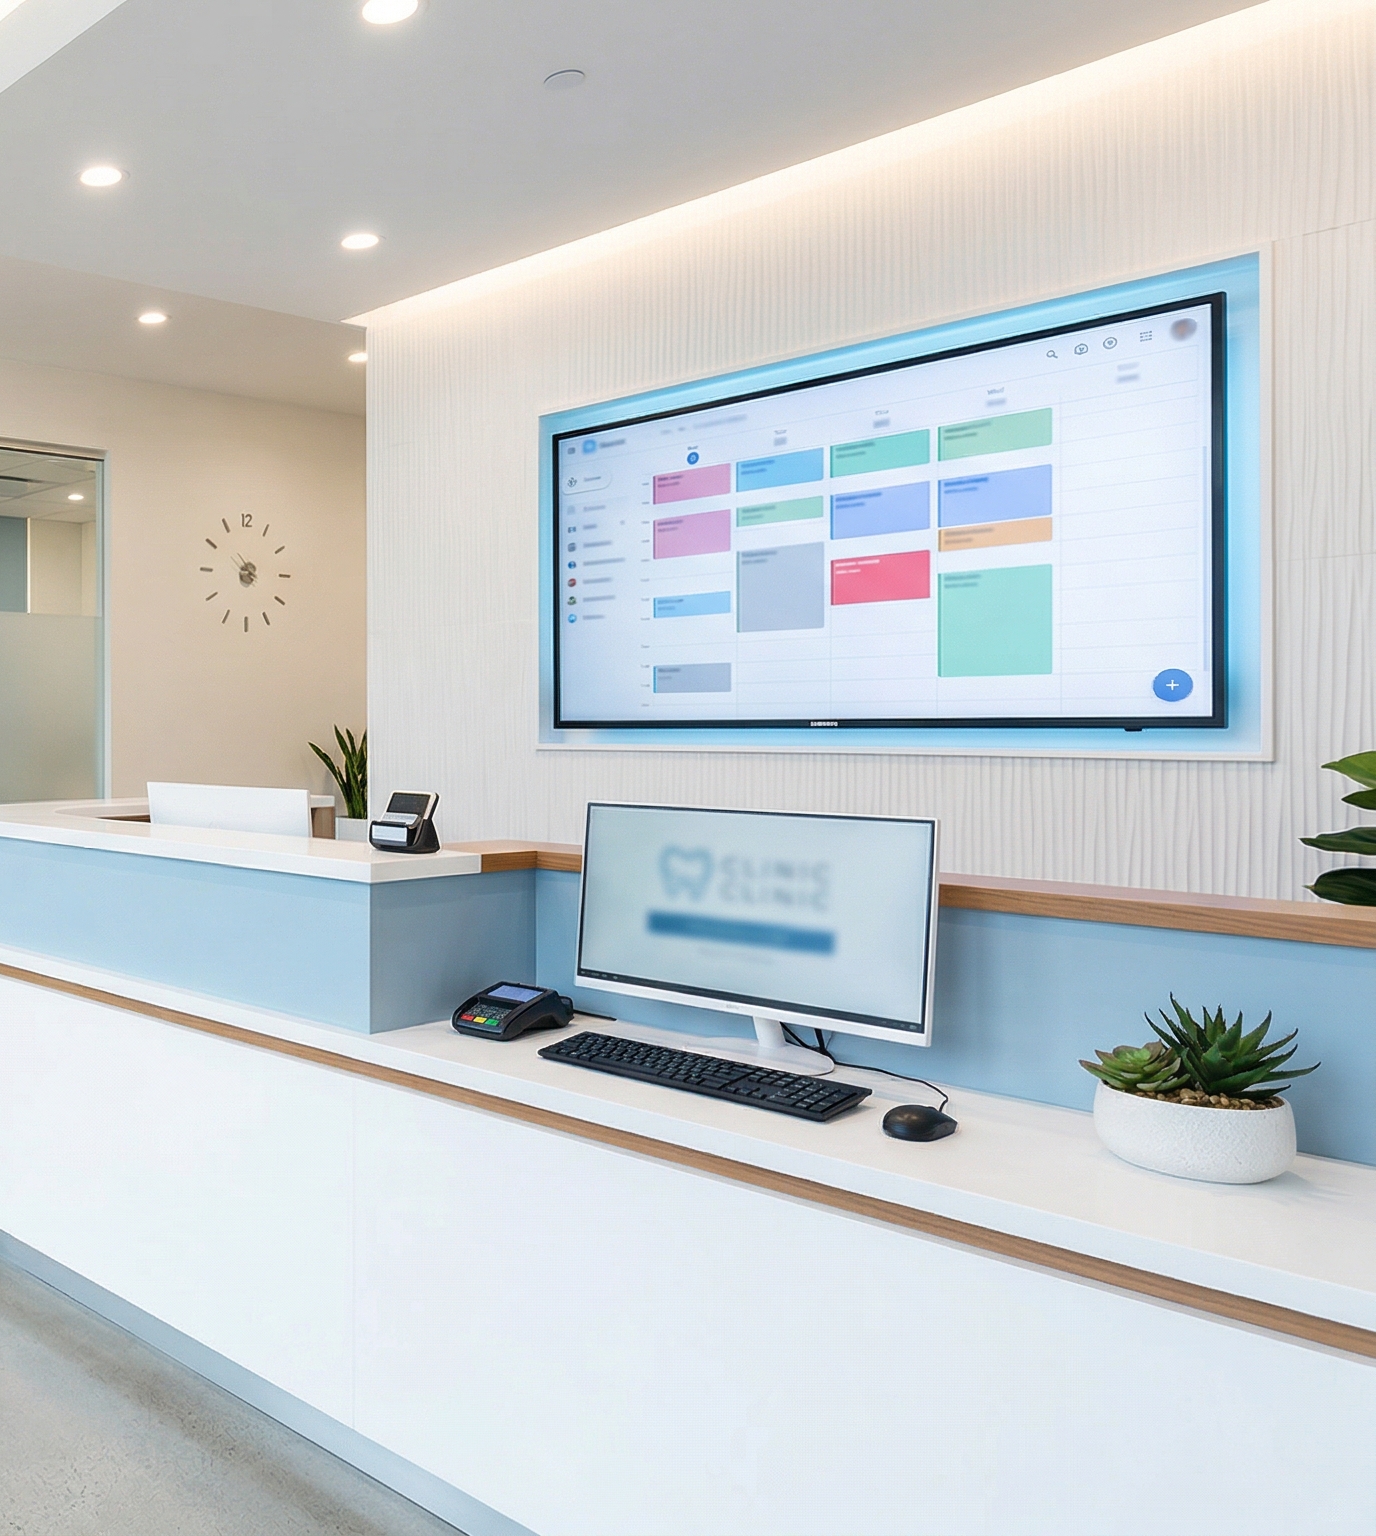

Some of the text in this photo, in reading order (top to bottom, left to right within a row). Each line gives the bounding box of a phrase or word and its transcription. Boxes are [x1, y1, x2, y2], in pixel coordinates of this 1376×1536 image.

[241, 513, 253, 528] 12
[722, 855, 830, 882] CLINIC
[720, 882, 829, 911] CLINIC
